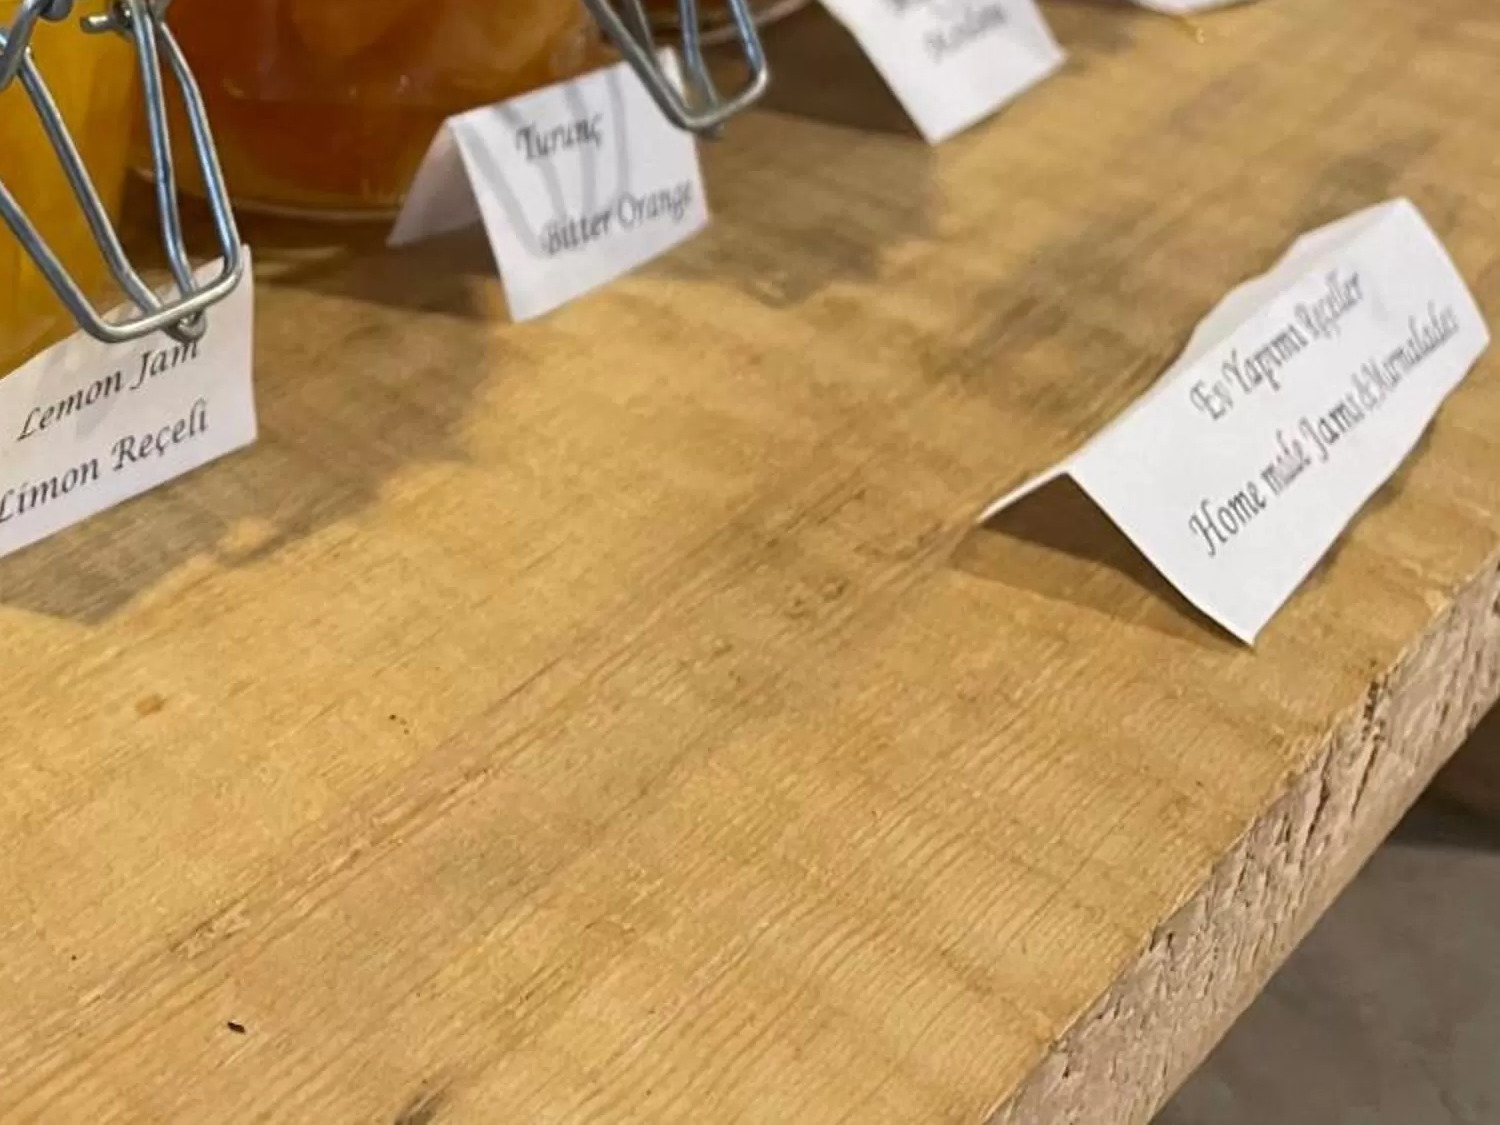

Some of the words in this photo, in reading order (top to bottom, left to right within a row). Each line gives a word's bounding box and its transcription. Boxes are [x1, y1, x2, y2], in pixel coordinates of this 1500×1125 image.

[541, 205, 614, 255] Bitter
[617, 179, 694, 230] Orange
[17, 371, 125, 442] Lemon
[129, 339, 201, 391] Jam
[111, 396, 209, 472] Reçeli
[1188, 479, 1267, 557] Home
[1298, 392, 1366, 463] Jams
